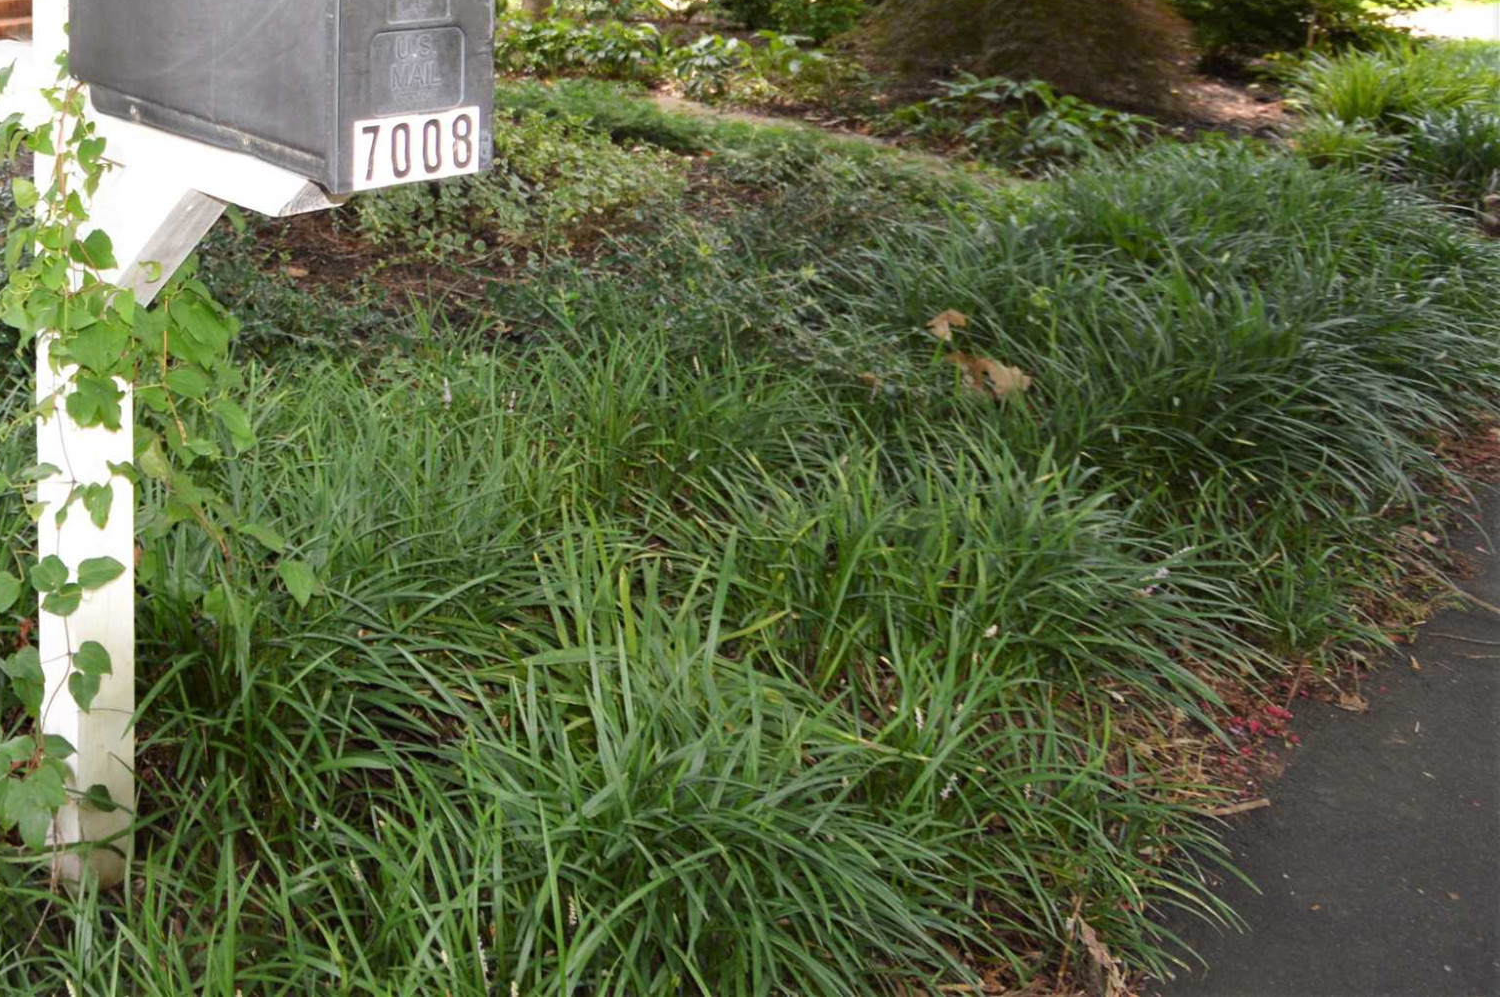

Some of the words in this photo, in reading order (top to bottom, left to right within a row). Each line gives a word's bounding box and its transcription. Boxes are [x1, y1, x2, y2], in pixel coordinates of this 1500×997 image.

[395, 34, 437, 60] U.S.
[391, 61, 441, 91] MAIL
[362, 114, 472, 181] 7008
